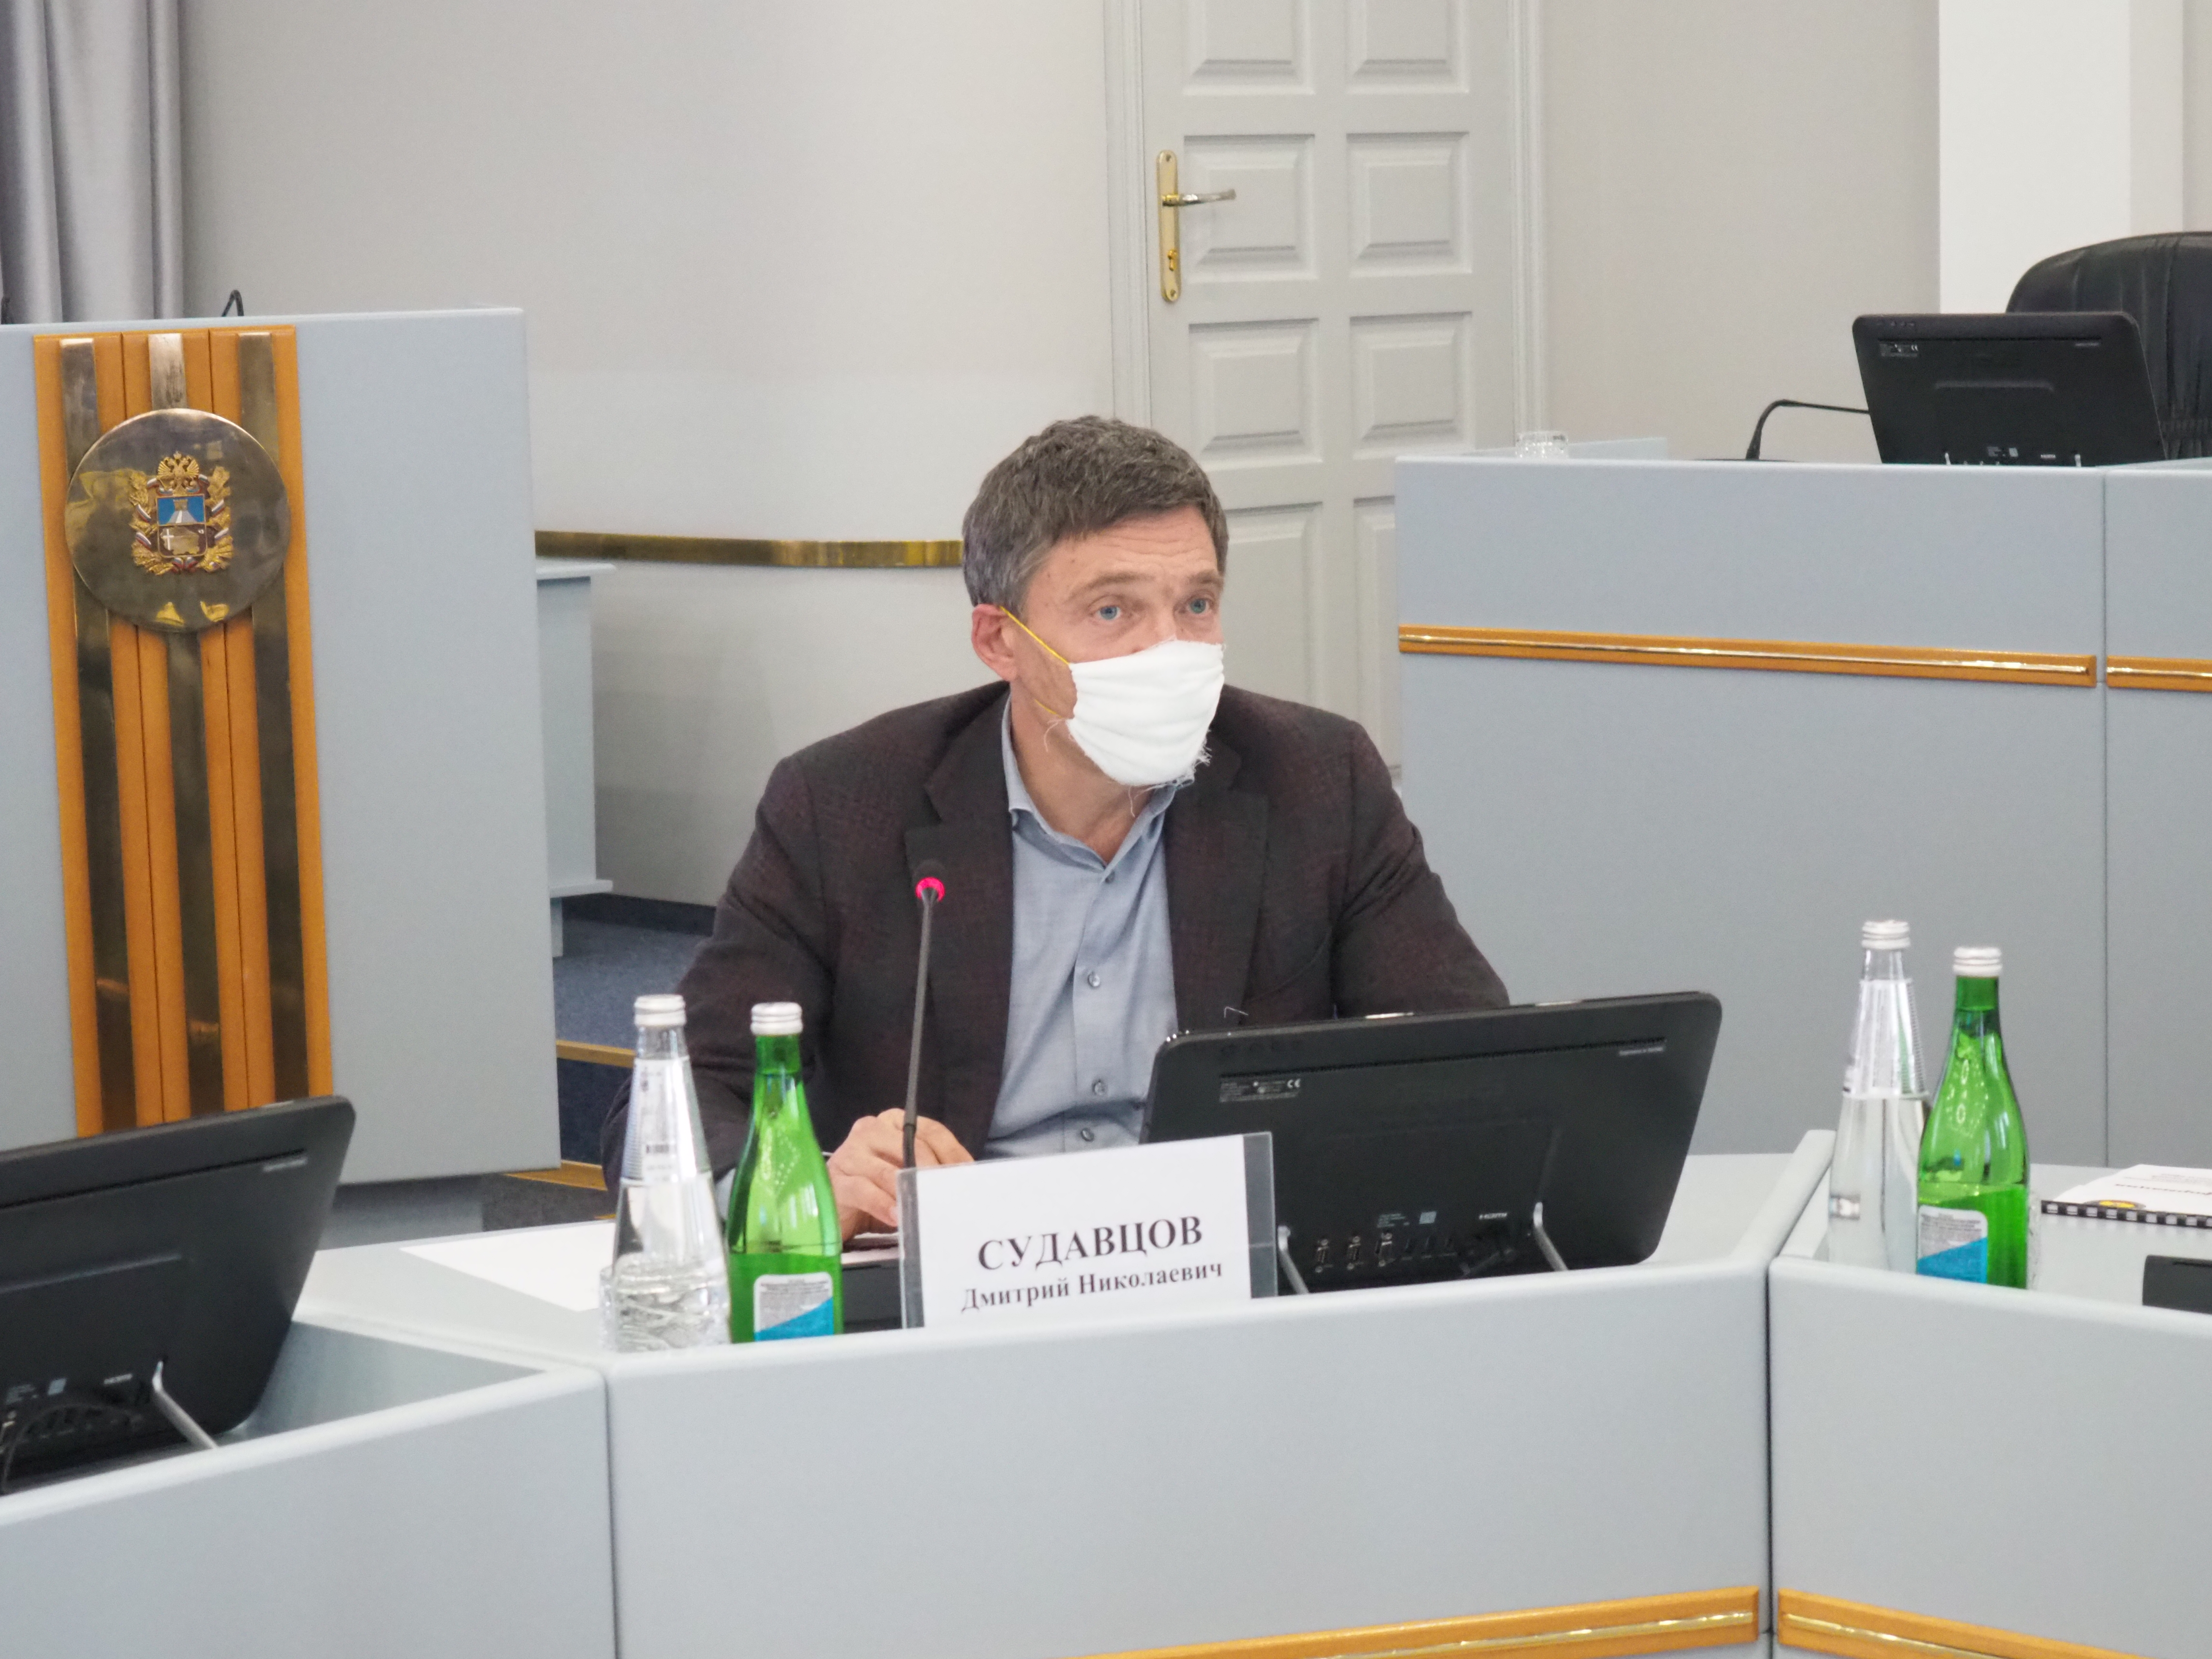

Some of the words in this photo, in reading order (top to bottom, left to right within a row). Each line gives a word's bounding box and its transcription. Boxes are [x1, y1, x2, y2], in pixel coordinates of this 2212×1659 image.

[978, 1216, 1202, 1270] СУДАВЦОВ
[961, 1278, 1070, 1312] Дмитрий
[1079, 1263, 1222, 1294] Николаевич
